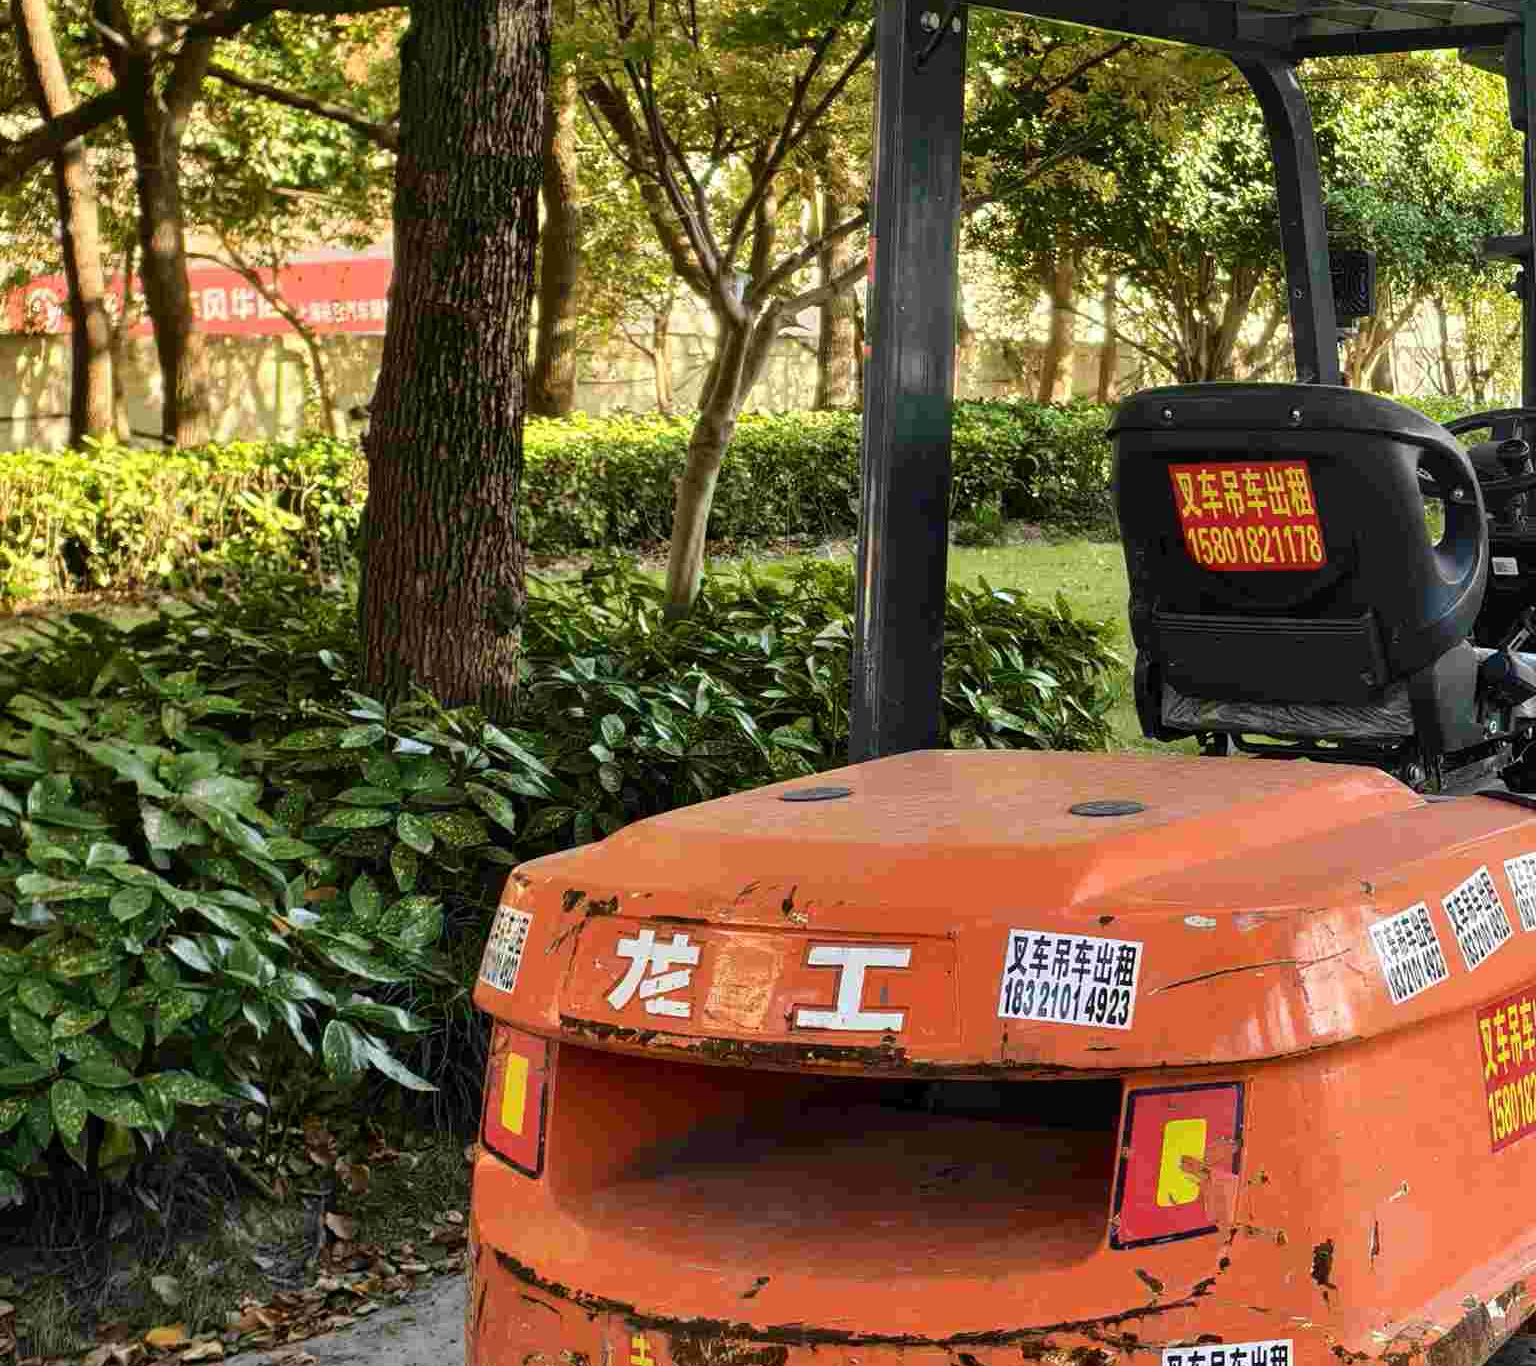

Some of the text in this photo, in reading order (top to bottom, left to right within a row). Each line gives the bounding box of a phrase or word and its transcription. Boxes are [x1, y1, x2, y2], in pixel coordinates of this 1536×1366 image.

[1176, 467, 1314, 519] 叉车吊车出租
[1188, 525, 1322, 564] 15801821178
[1008, 935, 1136, 986] 叉车吊车出租
